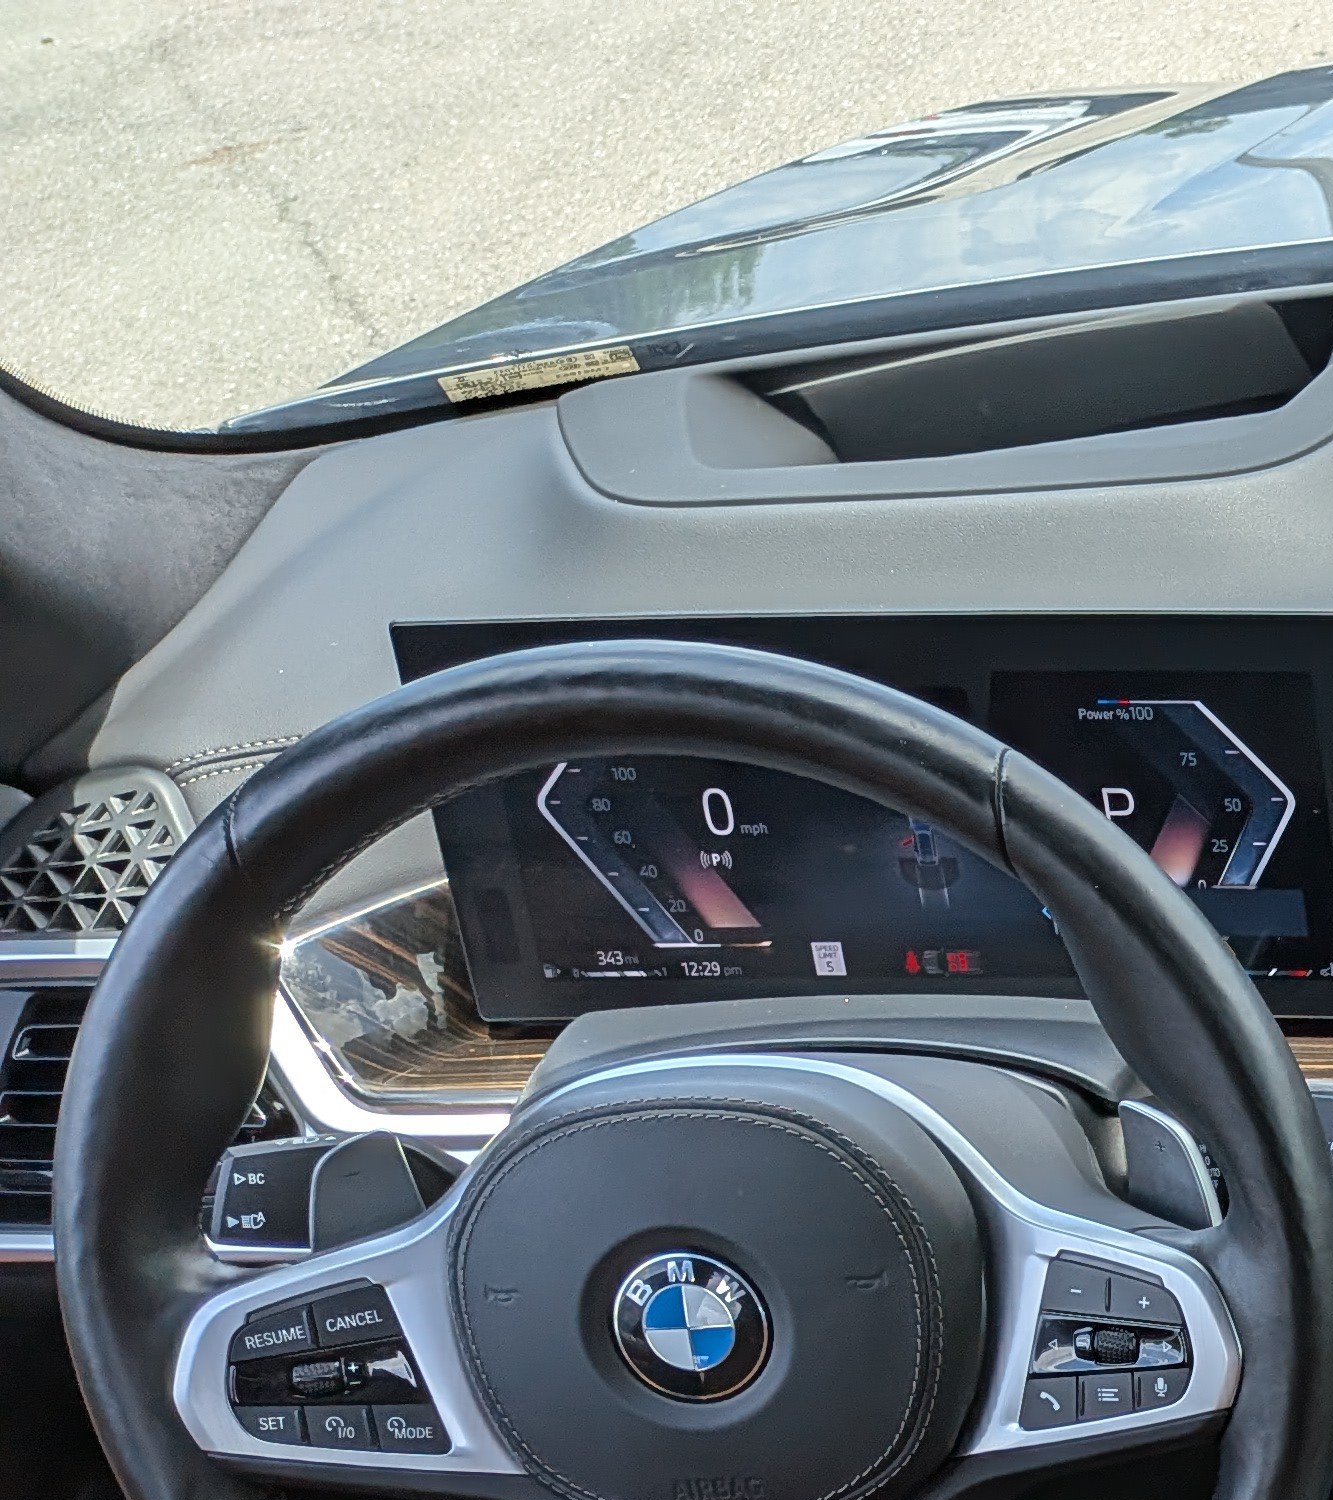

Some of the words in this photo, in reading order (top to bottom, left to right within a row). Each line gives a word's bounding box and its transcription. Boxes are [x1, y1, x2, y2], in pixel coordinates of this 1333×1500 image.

[1077, 708, 1114, 720] Power
[1179, 751, 1197, 767] 75
[611, 767, 637, 781] 100
[591, 797, 611, 812] 80
[702, 787, 735, 836] 0
[1101, 787, 1135, 821] P
[1224, 797, 1242, 812] 50
[740, 822, 769, 837] mph
[613, 830, 632, 845] 60
[1211, 838, 1229, 853] 25
[640, 864, 658, 879] 40
[668, 899, 687, 913] 20
[693, 928, 704, 942] 0
[596, 950, 624, 966] 343
[680, 961, 721, 977] 12:29
[247, 1172, 266, 1186] BC
[625, 1259, 747, 1308] BMW
[325, 1309, 383, 1333] CANCEL
[244, 1324, 307, 1350] RESUME
[259, 1416, 286, 1431] SET
[394, 1425, 434, 1439] MODE
